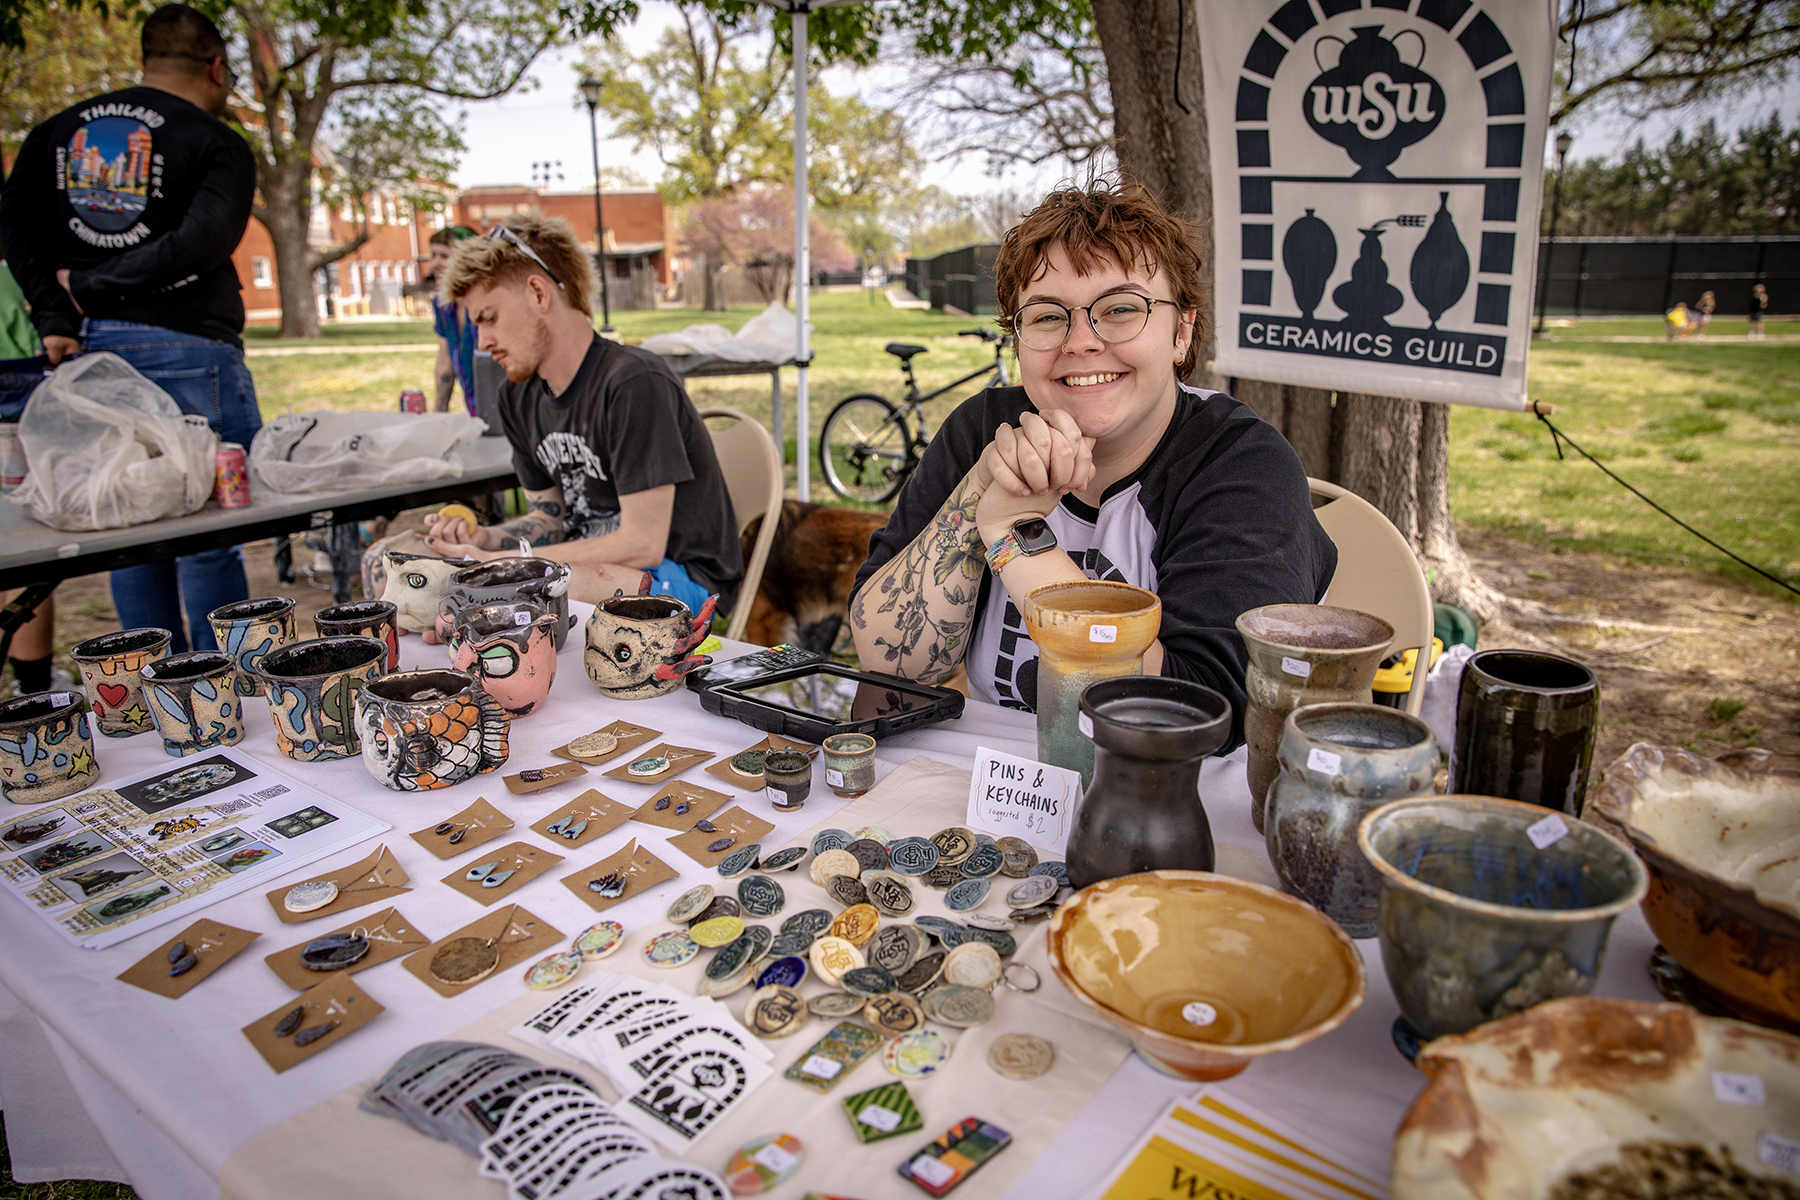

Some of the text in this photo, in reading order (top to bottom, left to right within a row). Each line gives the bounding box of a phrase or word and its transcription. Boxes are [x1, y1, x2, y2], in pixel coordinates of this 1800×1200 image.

[79, 103, 165, 128] THAILAND
[69, 217, 151, 248] CHINATOWN
[1246, 322, 1498, 368] CERAMICS GUILD
[990, 760, 1045, 788] PINS &
[985, 784, 1059, 816] KEYCHAINS
[988, 808, 1020, 822] suggested
[1025, 813, 1045, 834] $2
